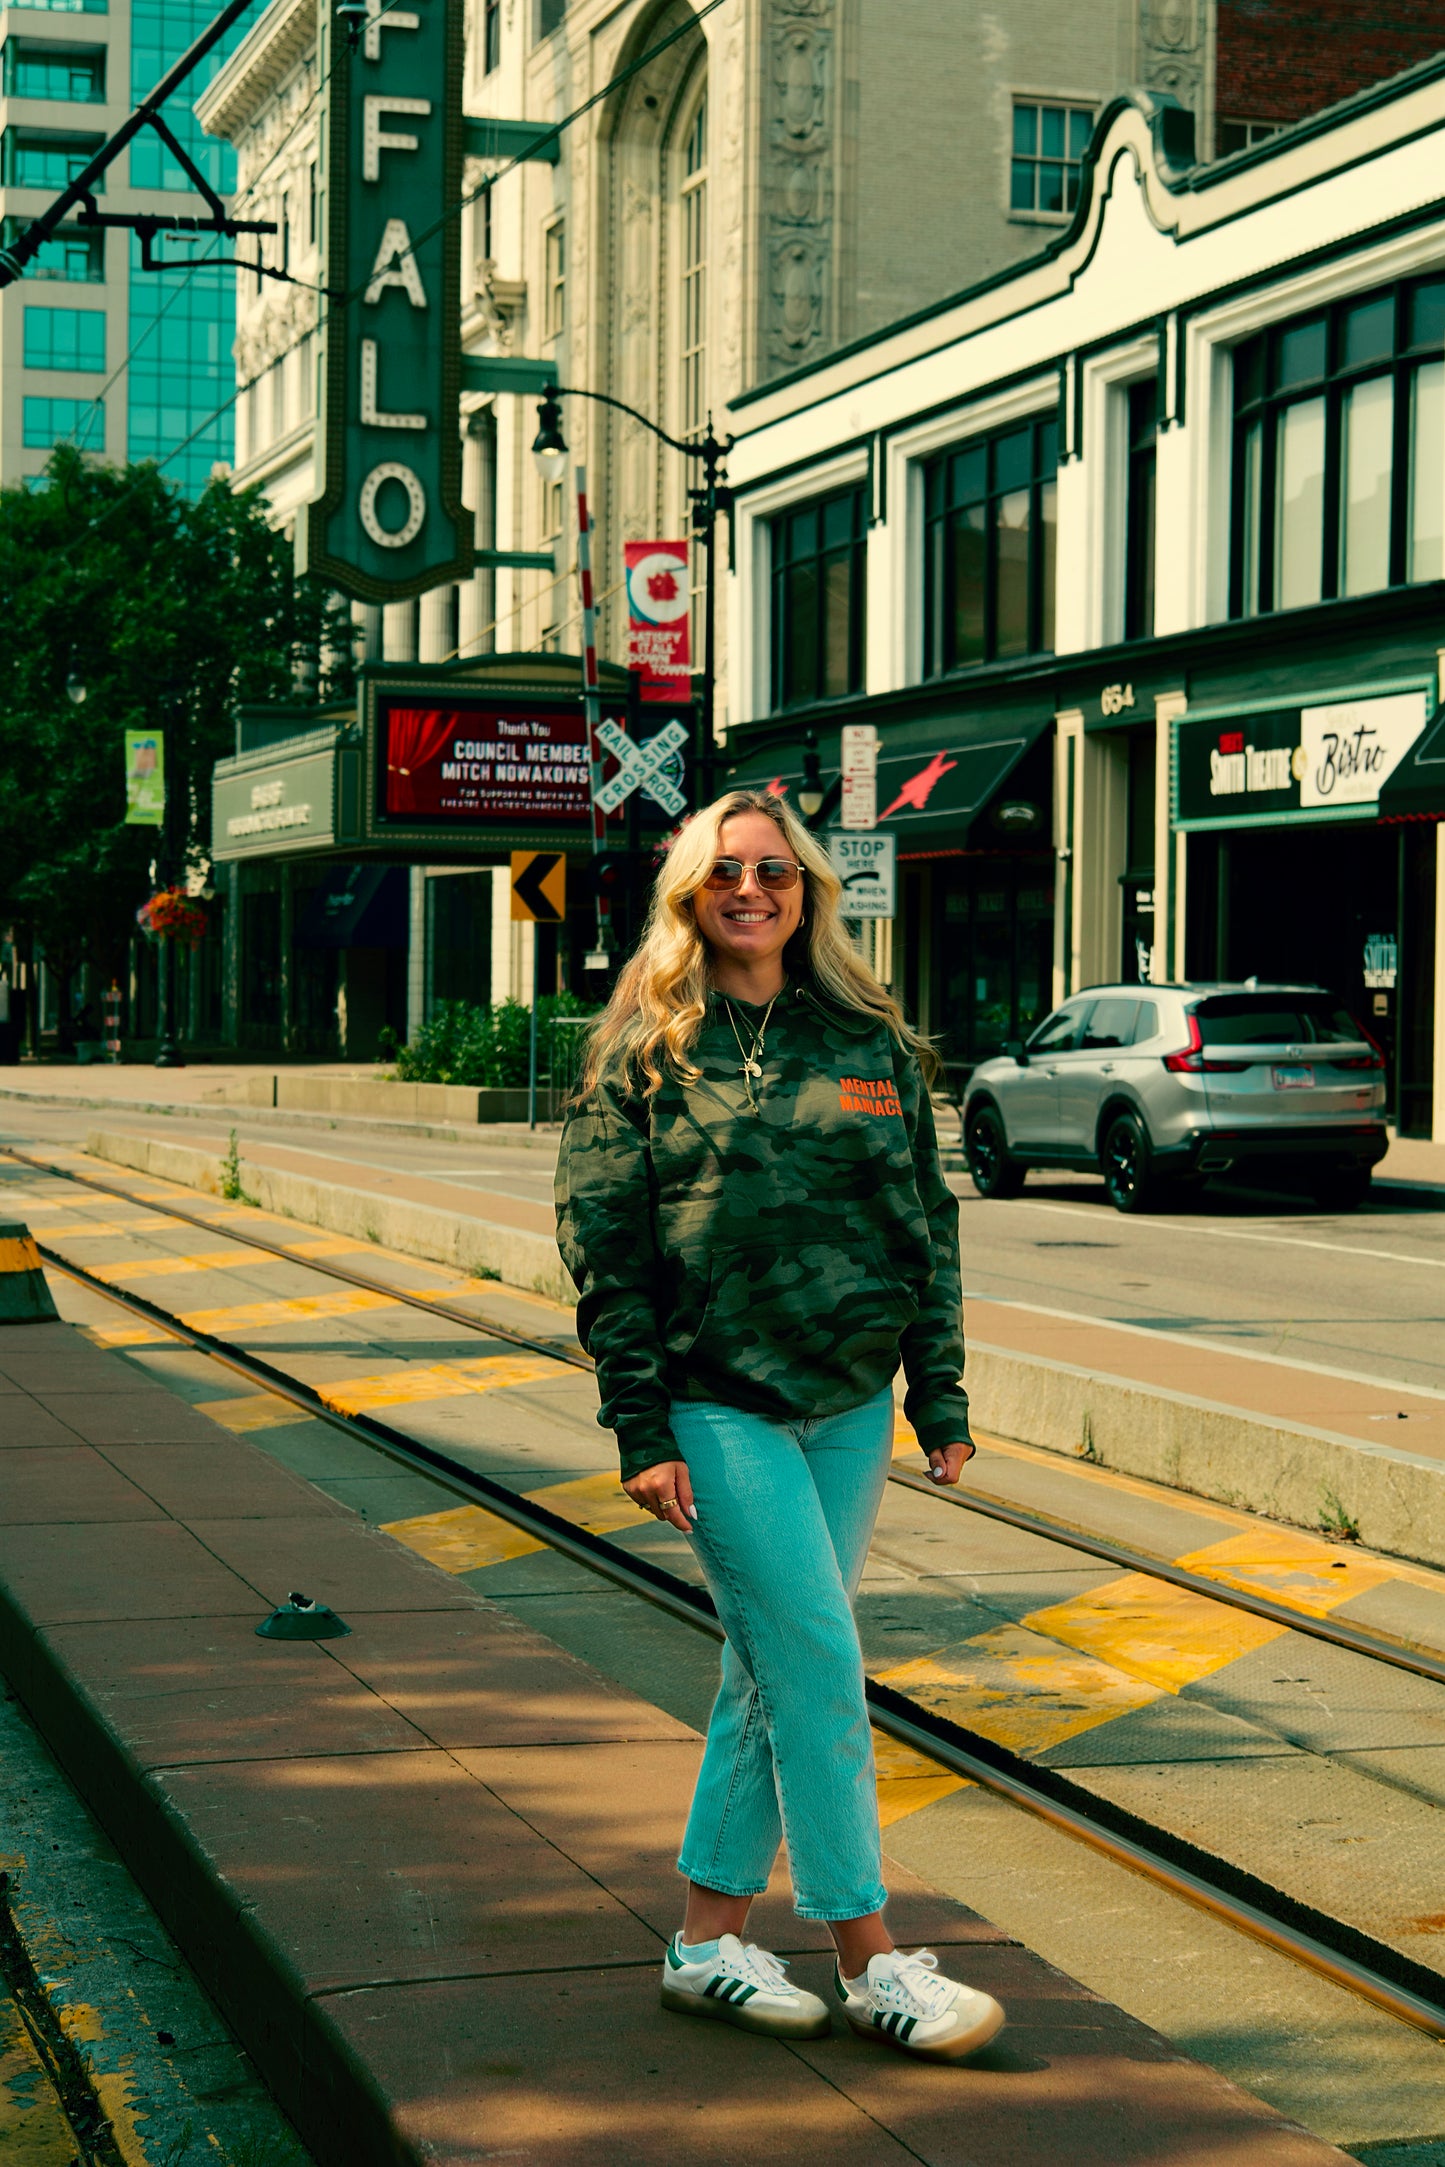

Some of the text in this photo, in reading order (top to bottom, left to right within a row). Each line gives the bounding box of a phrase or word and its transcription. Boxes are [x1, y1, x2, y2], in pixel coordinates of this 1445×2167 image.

[629, 631, 682, 644] SATISFY
[637, 642, 676, 655] IT ALL
[629, 653, 670, 665] DOWN
[651, 664, 691, 677] TOWN
[497, 720, 551, 737] Thank You
[453, 740, 520, 761] COUNCIL
[600, 724, 682, 811] RAIL ROAD
[602, 729, 681, 806] CROSSING
[1316, 724, 1388, 795] Bistro
[442, 762, 592, 784] MITCH NOWAKOWS
[839, 841, 886, 857] STOP
[847, 860, 876, 870] HERE
[856, 886, 887, 896] WHEN
[839, 1077, 897, 1098] MENTAL
